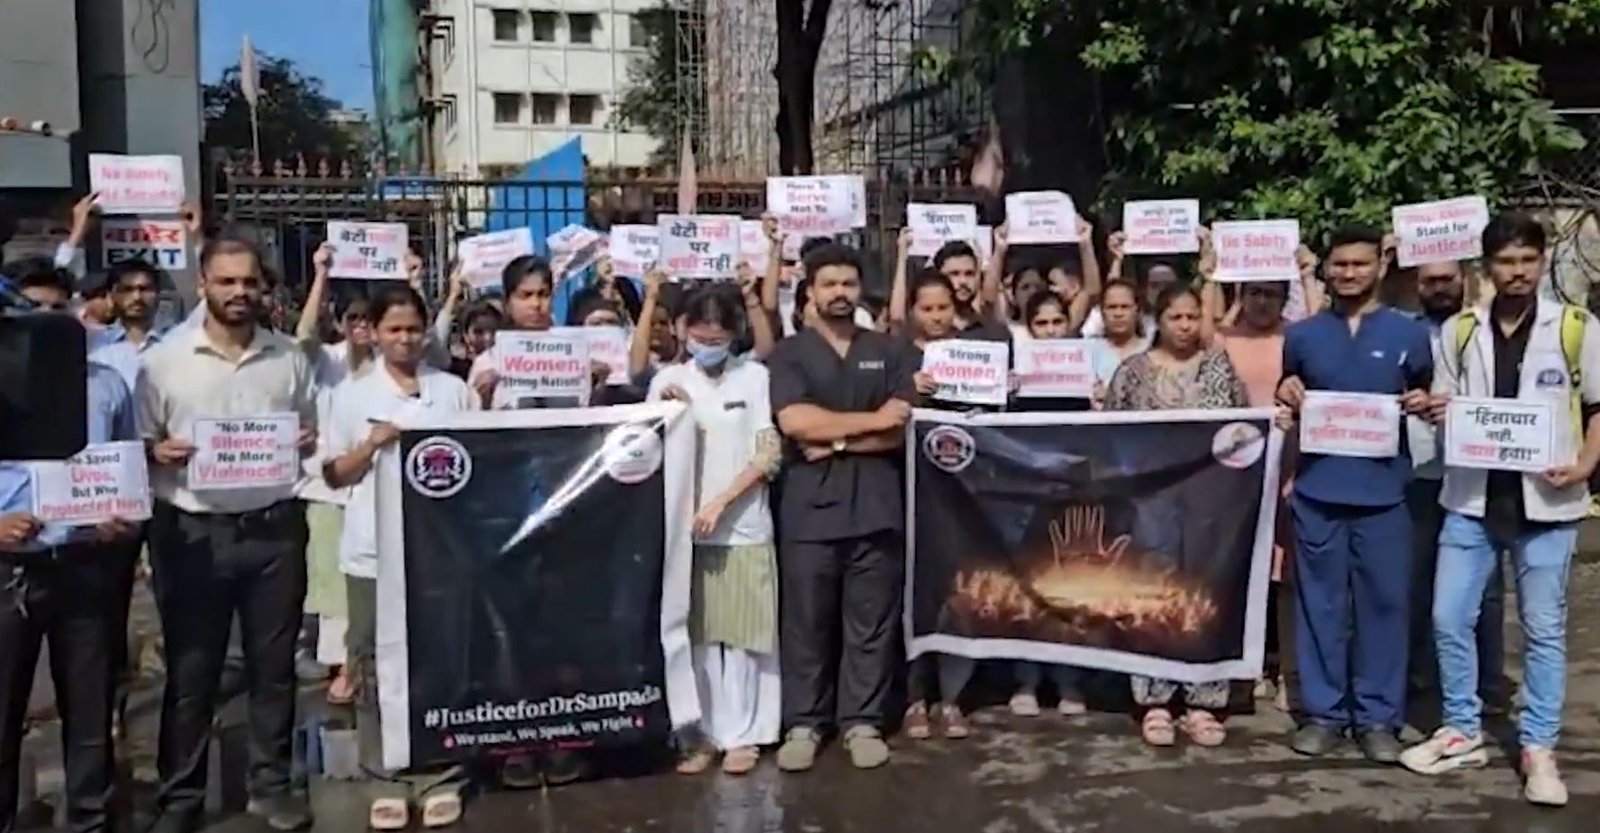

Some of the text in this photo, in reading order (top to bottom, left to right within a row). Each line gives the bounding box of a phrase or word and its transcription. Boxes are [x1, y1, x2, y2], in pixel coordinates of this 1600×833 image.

[1416, 223, 1449, 237] Stand
[689, 242, 710, 253] पर
[107, 248, 182, 265] EXIT
[244, 422, 277, 432] More
[240, 451, 273, 462] More
[71, 486, 91, 498] But
[423, 686, 662, 727] #JusticeforDrSampada
[455, 733, 476, 746] We
[518, 726, 538, 740] We
[582, 720, 601, 733] We
